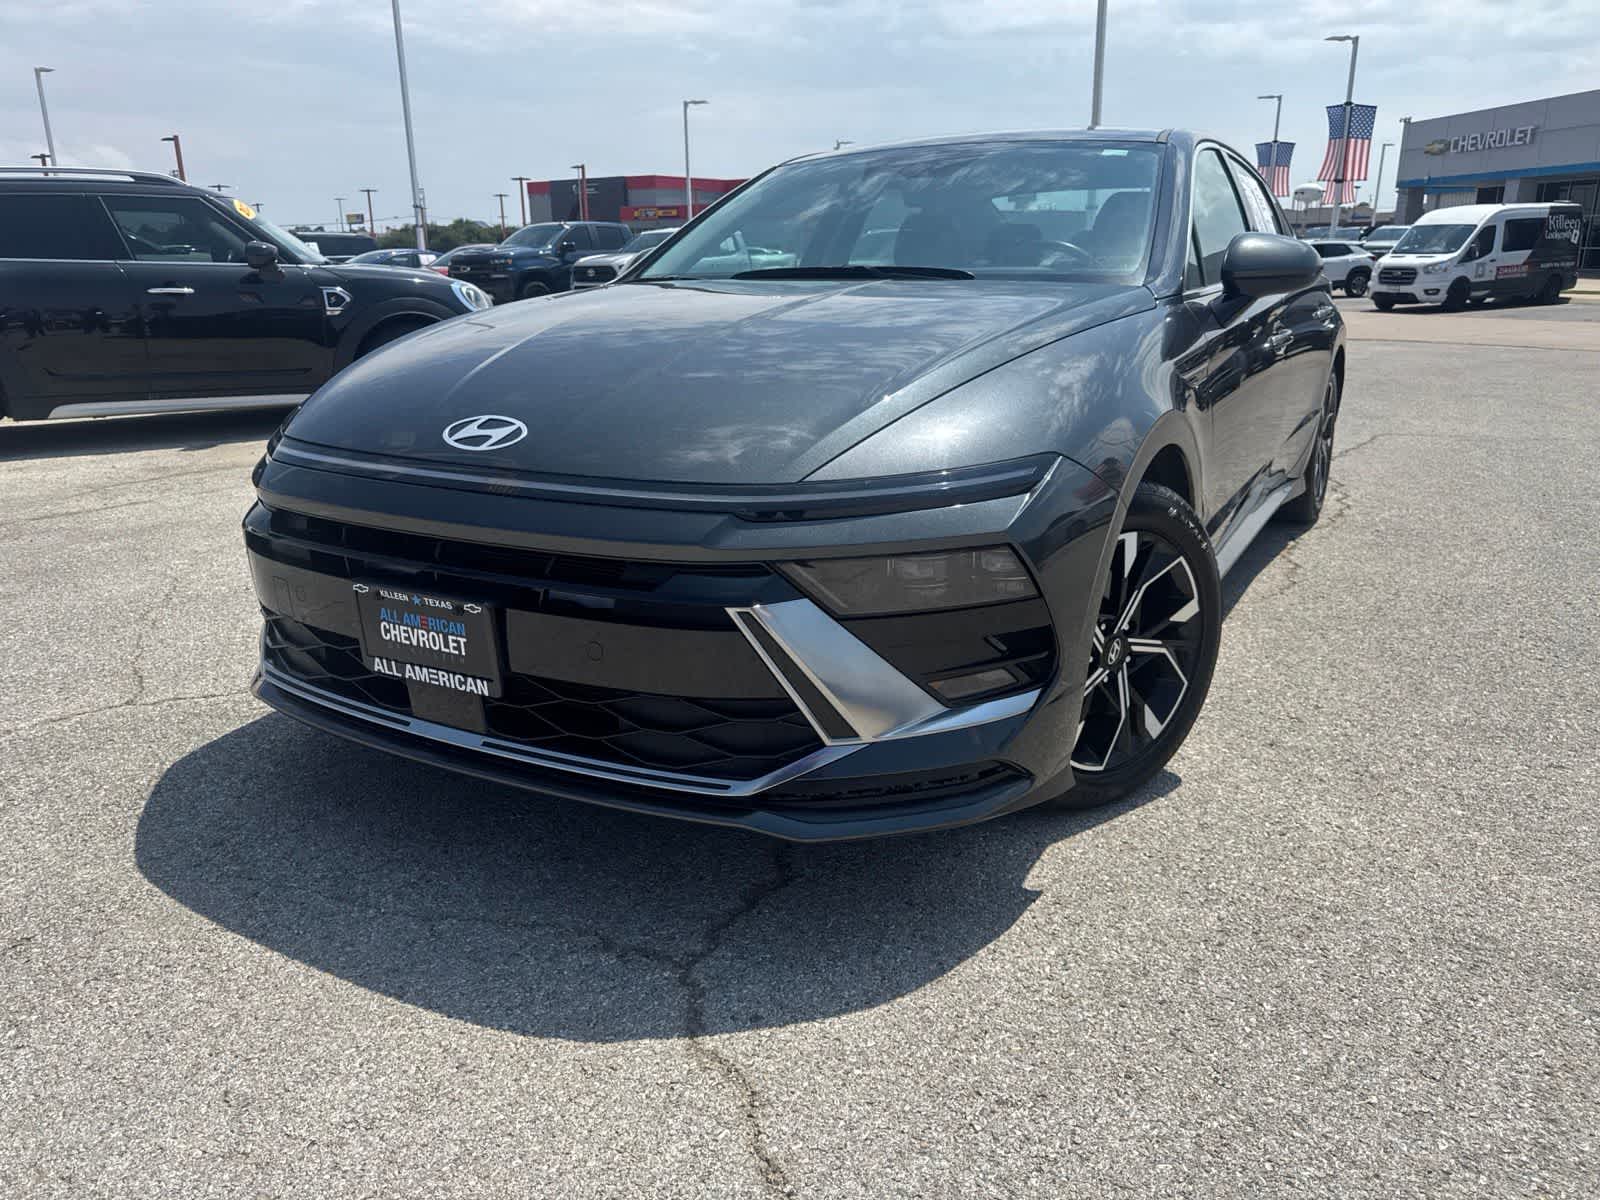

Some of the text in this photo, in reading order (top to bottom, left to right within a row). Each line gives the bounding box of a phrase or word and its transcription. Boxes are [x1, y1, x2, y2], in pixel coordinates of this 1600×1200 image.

[1450, 126, 1534, 153] CHEVROLET
[1549, 215, 1580, 231] Killeen
[380, 589, 453, 610] KILLEEN TEXAS
[380, 607, 465, 636] ALL AMERICAN
[380, 621, 467, 656] CHEVROLET
[374, 657, 402, 677] ALL
[405, 664, 489, 697] AMERICAN
